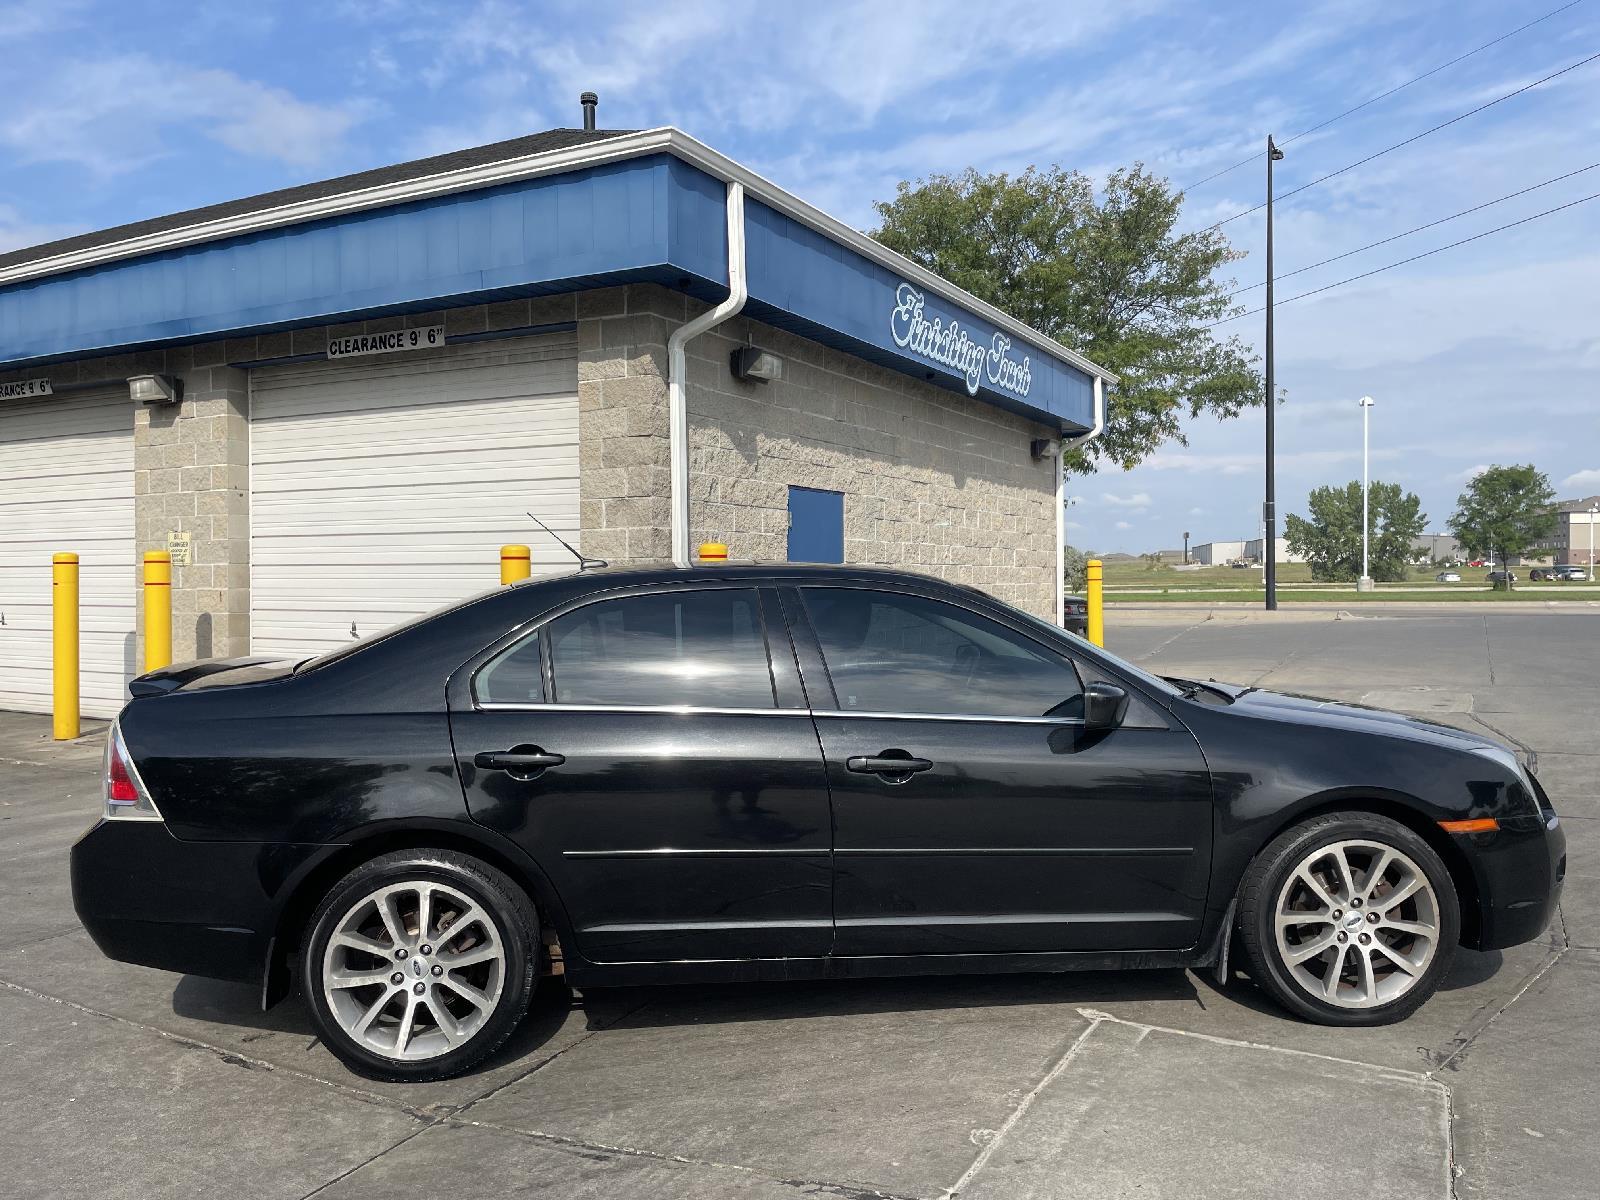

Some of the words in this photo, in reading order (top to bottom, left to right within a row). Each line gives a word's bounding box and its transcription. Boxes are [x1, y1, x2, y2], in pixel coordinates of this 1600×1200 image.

[329, 333, 404, 355] CLEARANCE
[891, 282, 985, 396] Finishing
[986, 331, 1032, 397] Touch
